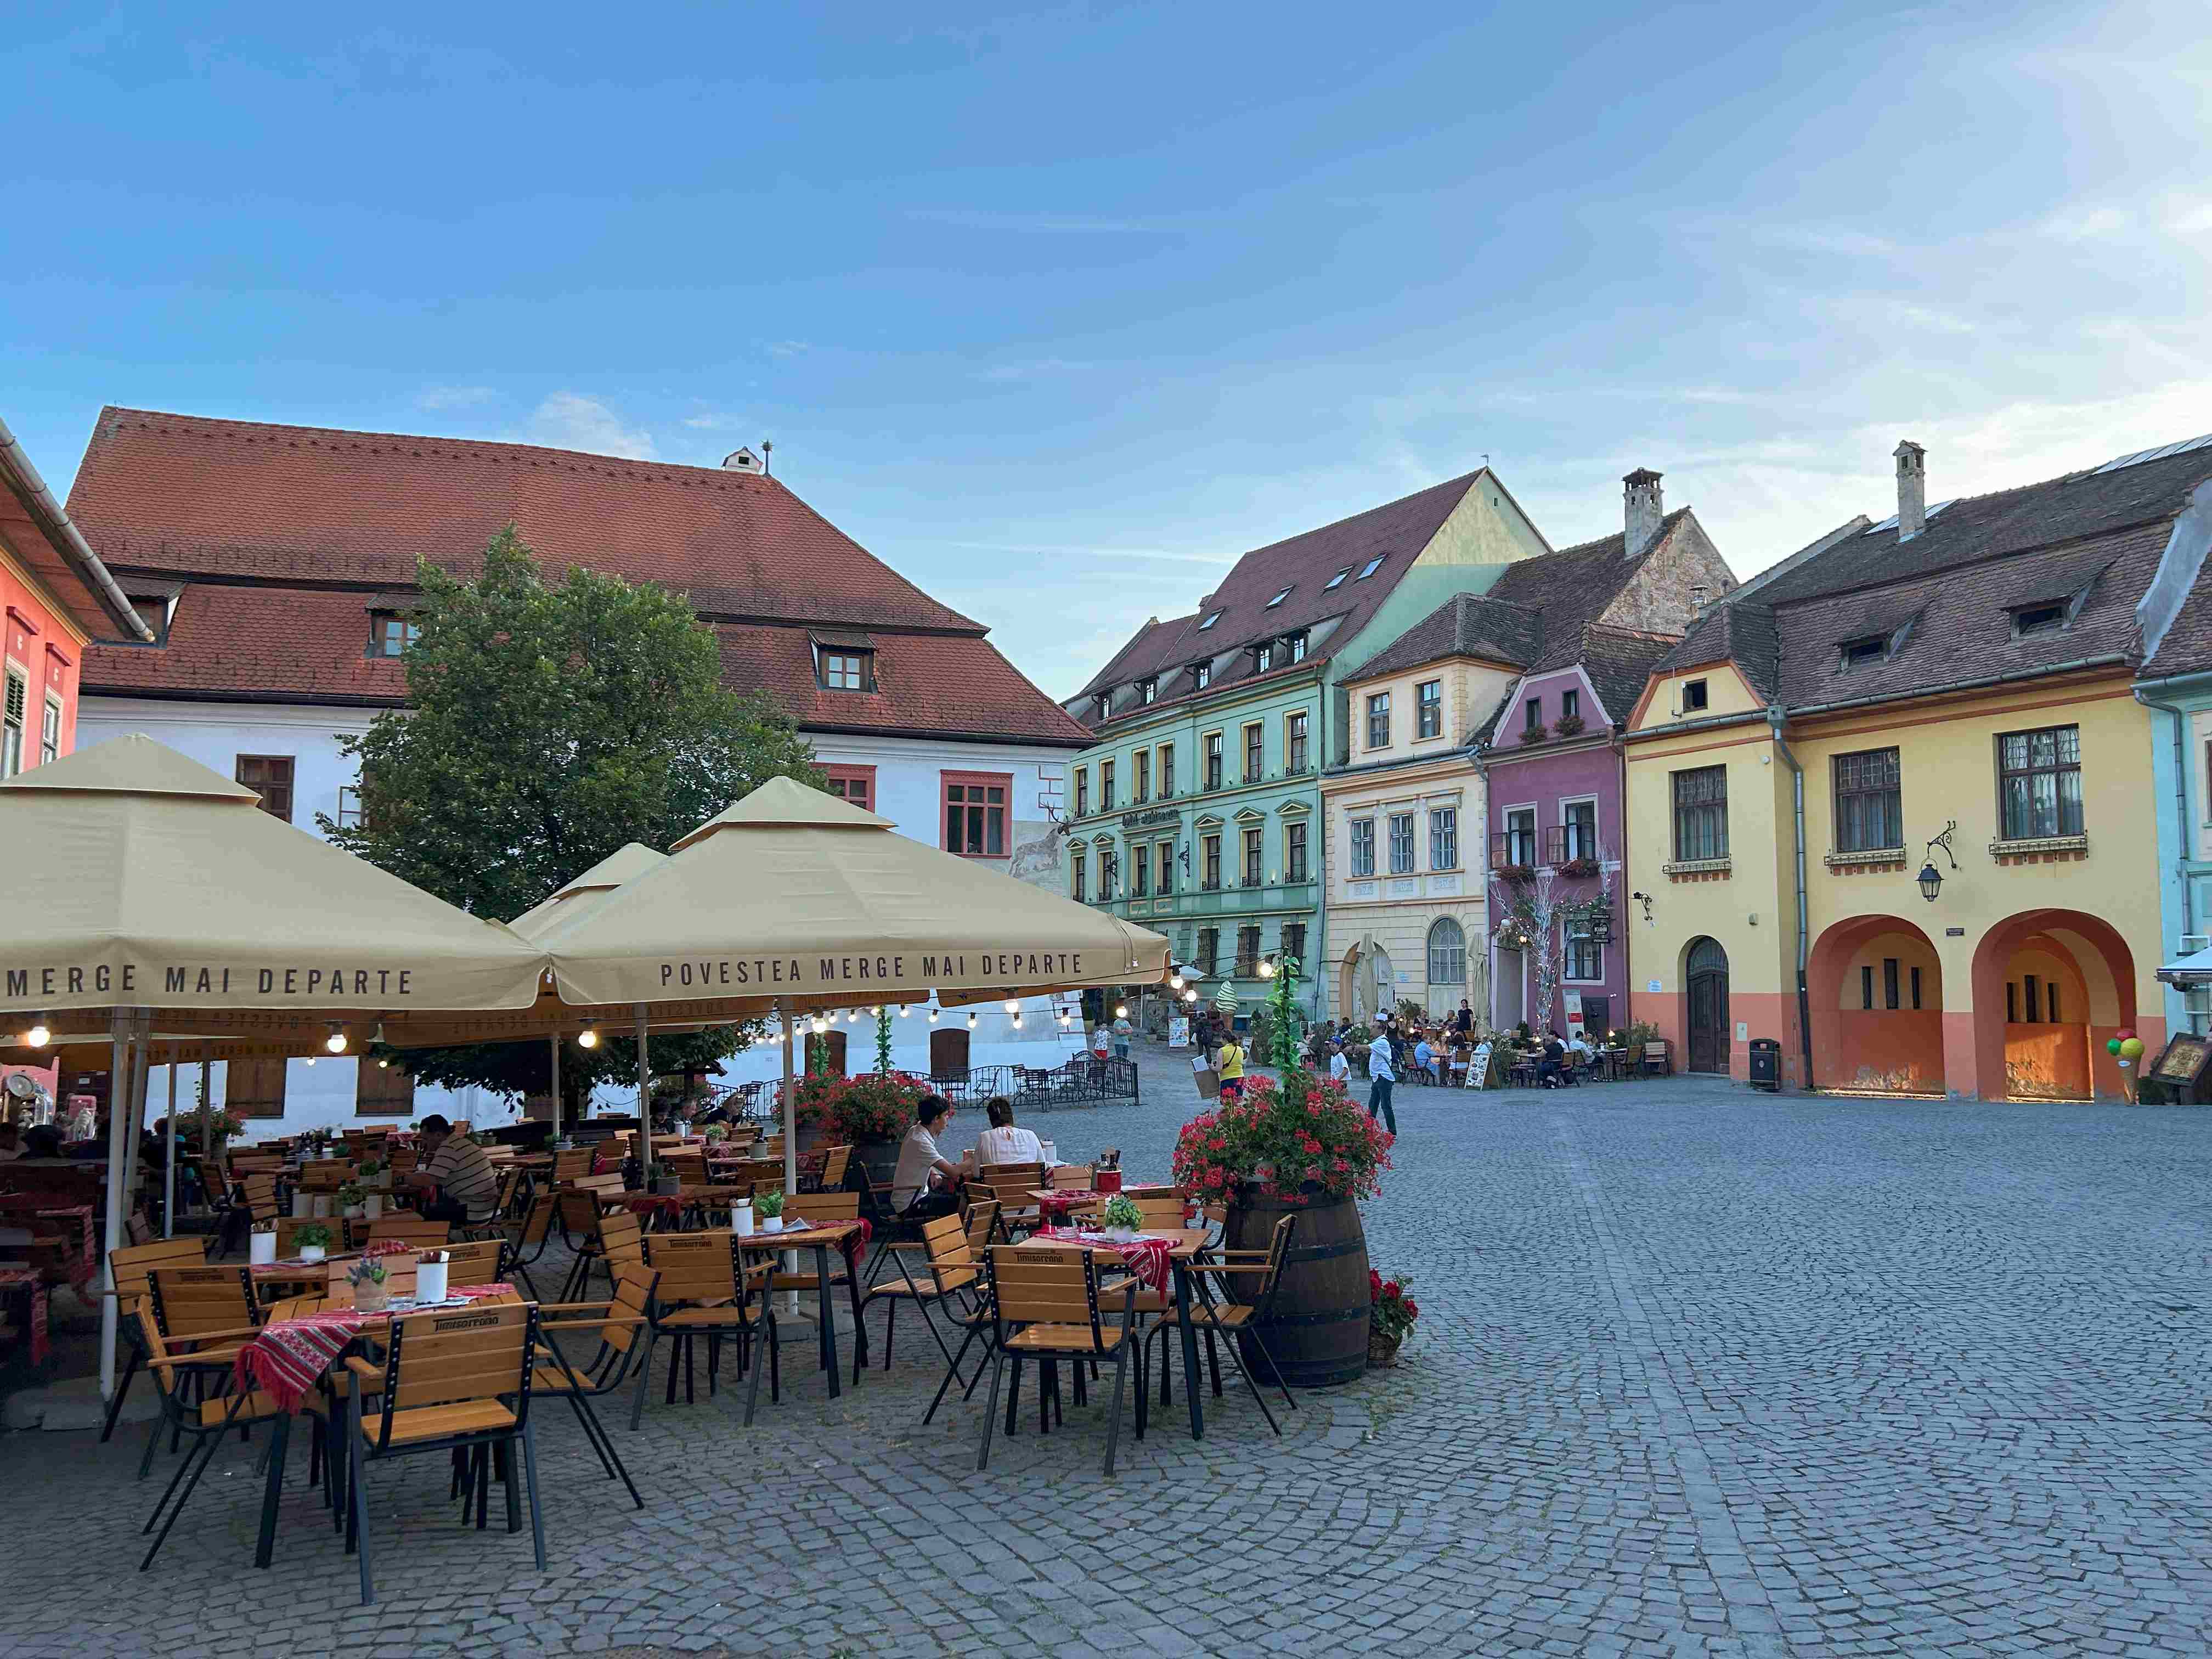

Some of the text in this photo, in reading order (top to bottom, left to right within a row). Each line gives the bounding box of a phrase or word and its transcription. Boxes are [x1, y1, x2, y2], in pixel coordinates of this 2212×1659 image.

[7, 964, 411, 996] MERGE MAI DEPARTE
[661, 953, 1081, 986] POVESTEA MERGE MAI DEPARTE
